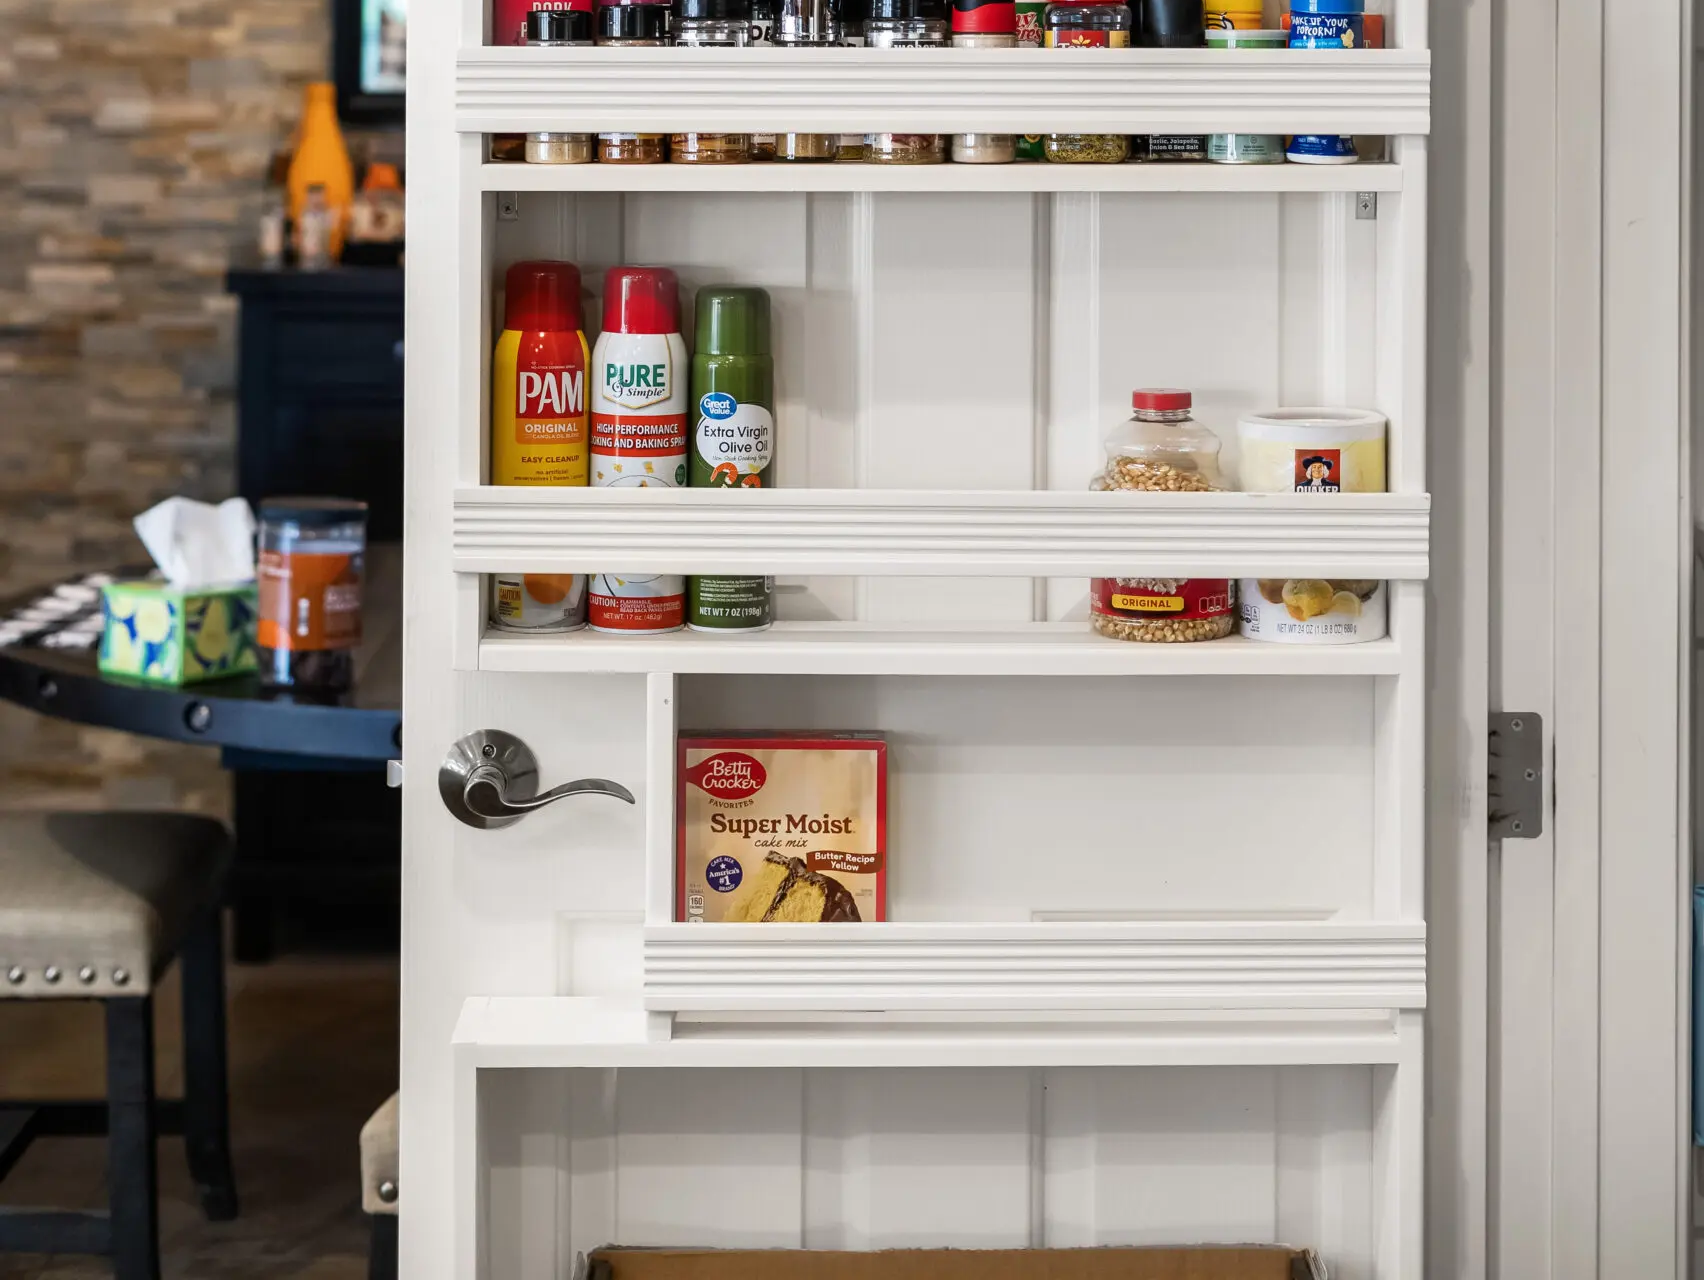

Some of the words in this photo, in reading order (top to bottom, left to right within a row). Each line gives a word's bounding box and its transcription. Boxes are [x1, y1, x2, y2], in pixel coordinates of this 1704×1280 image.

[1324, 18, 1349, 29] YOUR
[1296, 25, 1336, 37] POPCORN!
[606, 363, 666, 388] PURE
[518, 370, 584, 415] PAM
[626, 388, 662, 399] Simple
[703, 398, 731, 409] Great
[709, 407, 730, 415] Value
[524, 423, 579, 434] ORIGINAL
[596, 423, 614, 434] HIGH
[615, 423, 679, 436] PERFORMANCE
[704, 425, 735, 438] Extra
[737, 425, 768, 440] Virgin
[613, 437, 634, 449] AND
[635, 436, 669, 449] BAKING
[718, 441, 752, 453] Olive
[755, 440, 768, 452] Oil
[545, 455, 580, 463] CLEANUP
[1121, 598, 1172, 609] ORIGINAL
[699, 606, 712, 616] NET
[712, 607, 724, 617] WT
[725, 607, 730, 617] 7
[730, 607, 741, 617] OZ
[741, 606, 762, 618] (198g)
[1276, 624, 1288, 633] NET
[1288, 624, 1297, 634] WT
[1297, 625, 1305, 634] 24
[1305, 625, 1314, 634] OZ
[1321, 625, 1329, 634] LB
[707, 758, 753, 780] Betty
[702, 772, 761, 790] Crocker
[707, 798, 755, 809] FAVORITES
[710, 813, 782, 839] Super
[785, 813, 853, 834] Moist
[754, 835, 783, 848] cake
[785, 836, 809, 848] mix
[710, 857, 723, 867] CAKE
[723, 856, 735, 864] MIX
[814, 852, 844, 861] Butter
[845, 853, 876, 864] Recipe
[830, 860, 860, 872] Yellow
[708, 867, 740, 878] America's
[719, 875, 731, 886] #1
[718, 883, 736, 892] BRAND
[690, 897, 703, 906] 160
